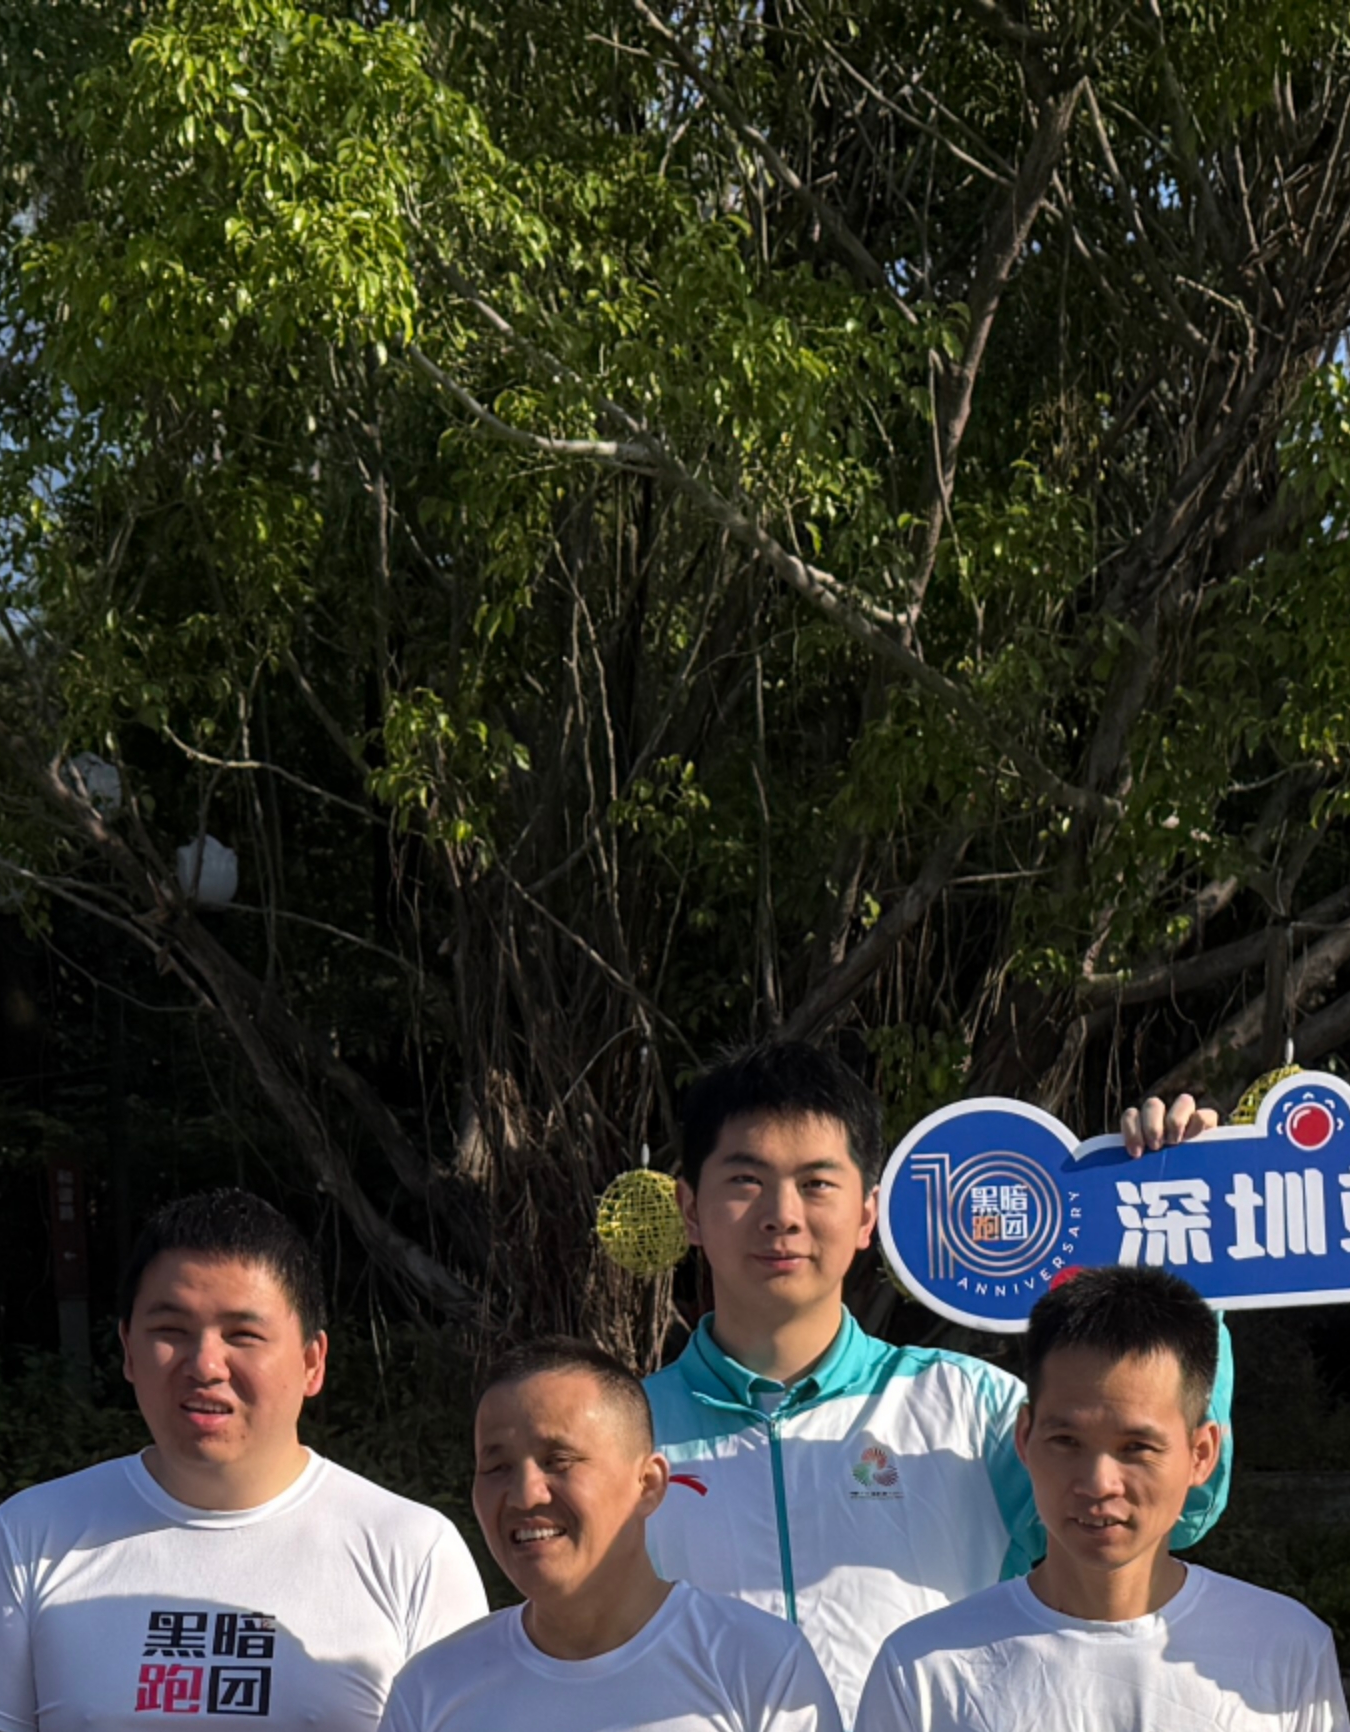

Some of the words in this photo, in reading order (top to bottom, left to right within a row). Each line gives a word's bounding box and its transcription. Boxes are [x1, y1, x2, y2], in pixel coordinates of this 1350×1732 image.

[971, 1184, 1028, 1213] 黑暗
[957, 1191, 1082, 1297] ANNIVERSARY
[972, 1213, 1028, 1242] 跑团
[142, 1611, 276, 1659] 黑暗
[135, 1663, 272, 1716] 跑团
